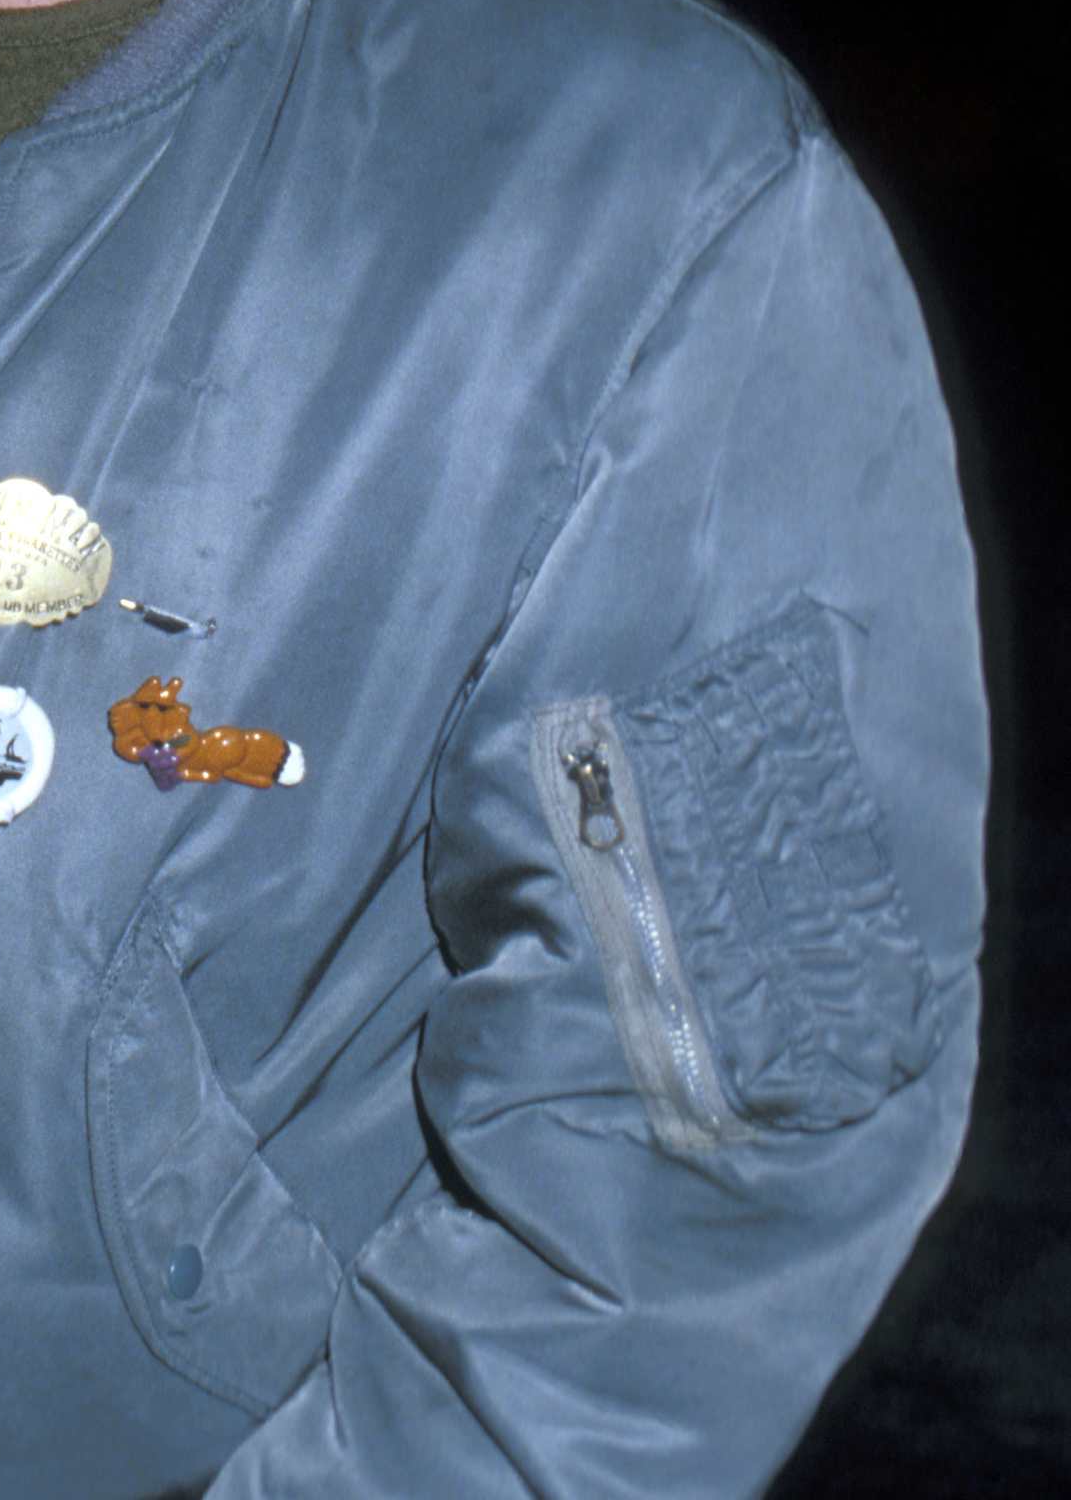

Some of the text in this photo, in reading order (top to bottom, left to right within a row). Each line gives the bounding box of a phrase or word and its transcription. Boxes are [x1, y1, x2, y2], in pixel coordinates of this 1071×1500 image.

[8, 531, 83, 573] CIGARETTES
[39, 501, 106, 561] MAN
[24, 593, 85, 614] MEMBER
